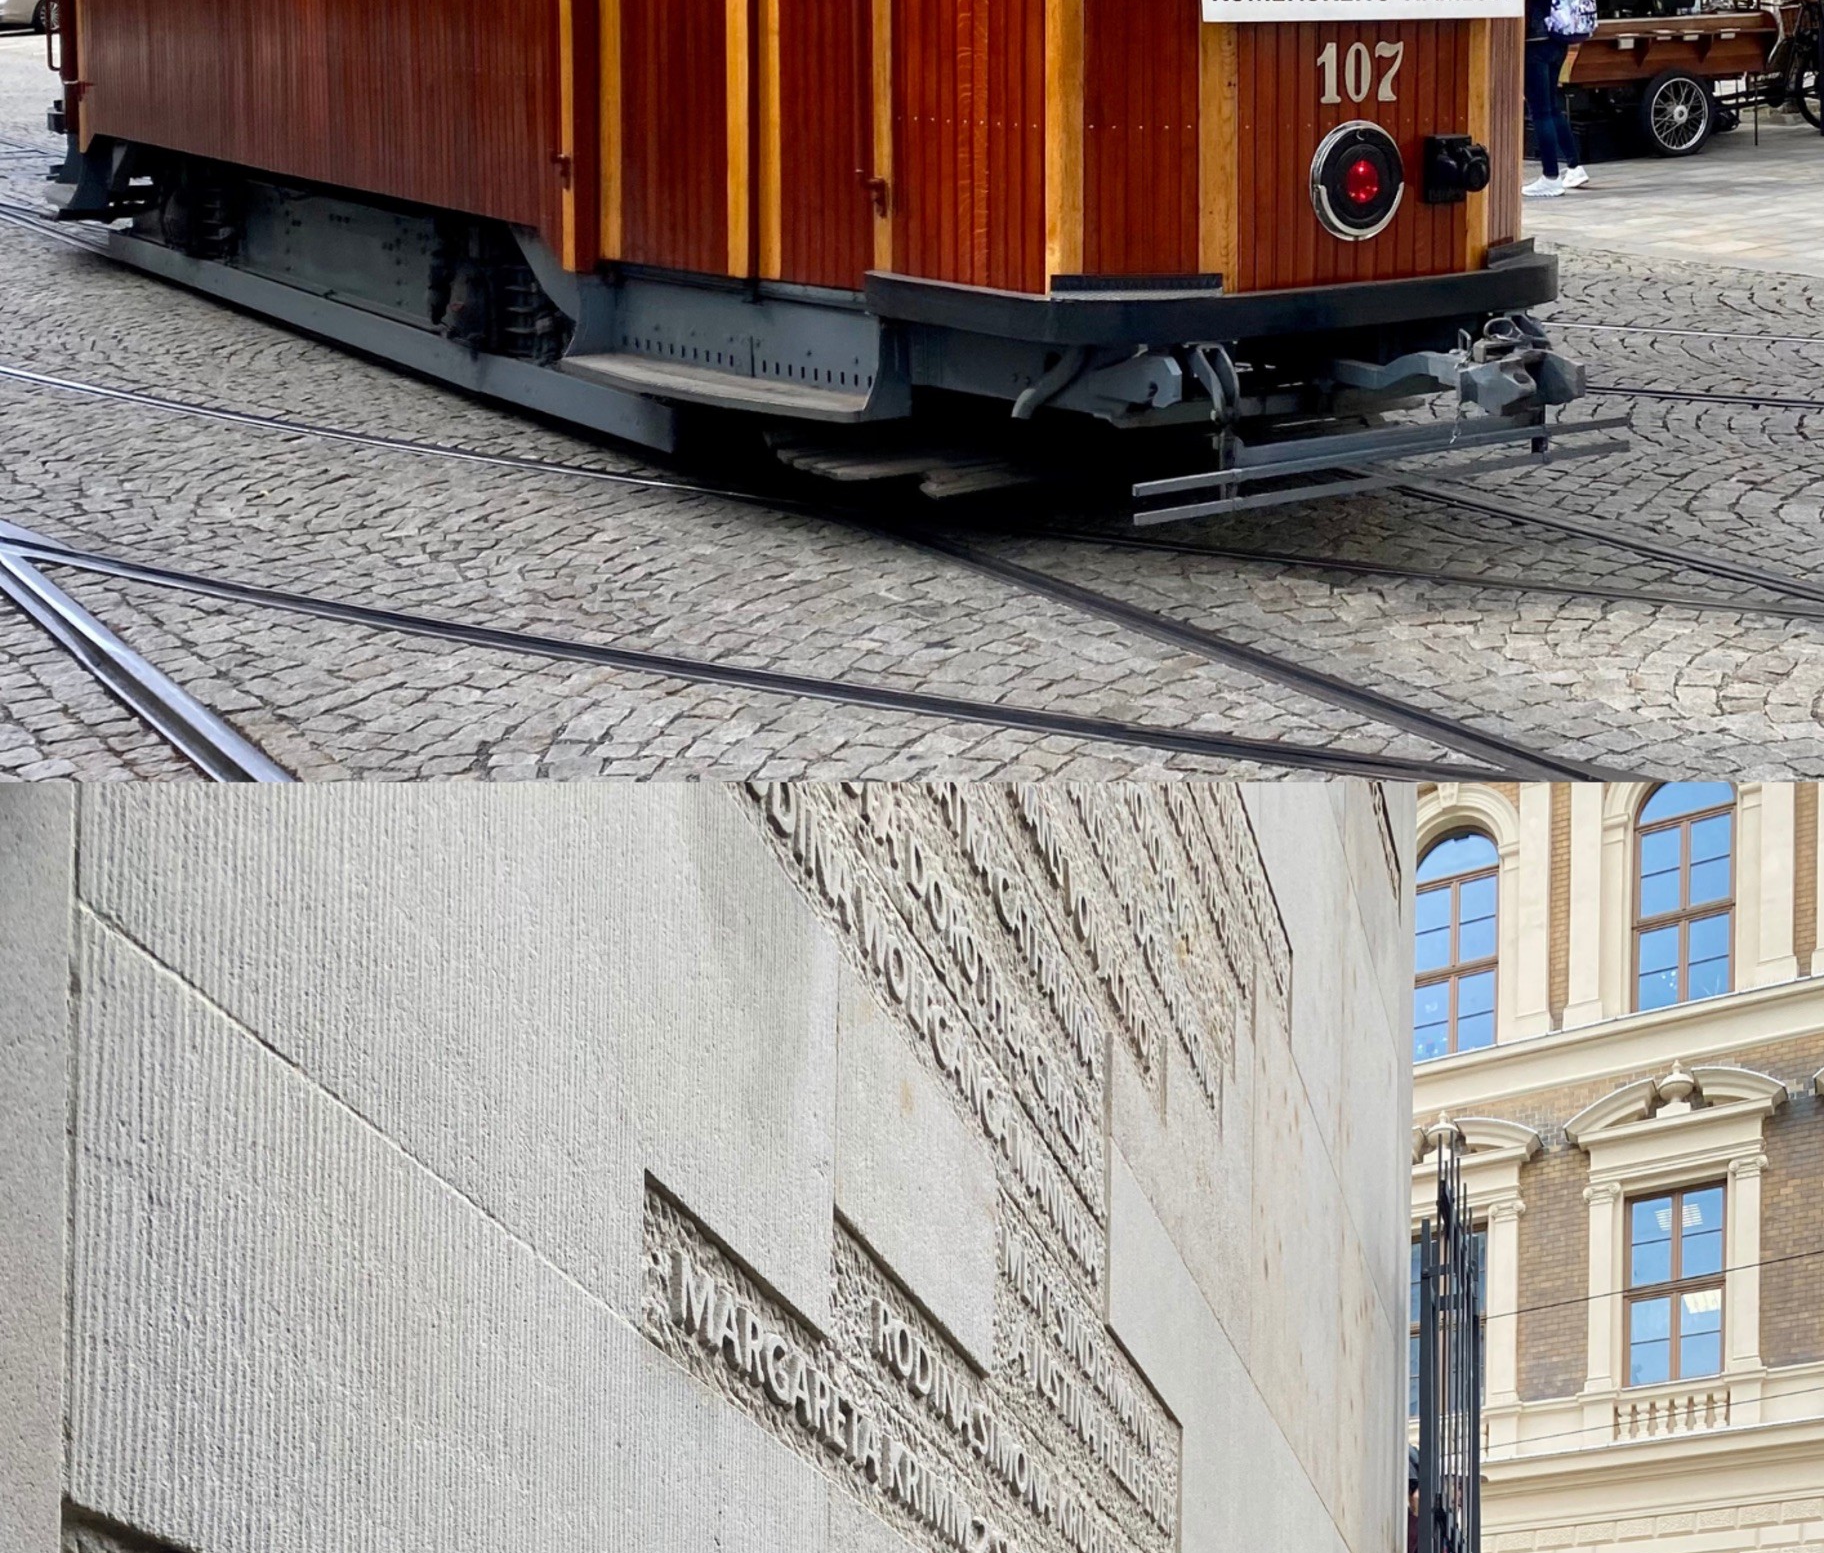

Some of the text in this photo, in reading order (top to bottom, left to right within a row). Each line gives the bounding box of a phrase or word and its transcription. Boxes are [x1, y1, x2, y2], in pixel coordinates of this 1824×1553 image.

[1316, 40, 1405, 104] 107
[669, 1240, 882, 1483] MARGARETA
[870, 1288, 971, 1449] RODINA
